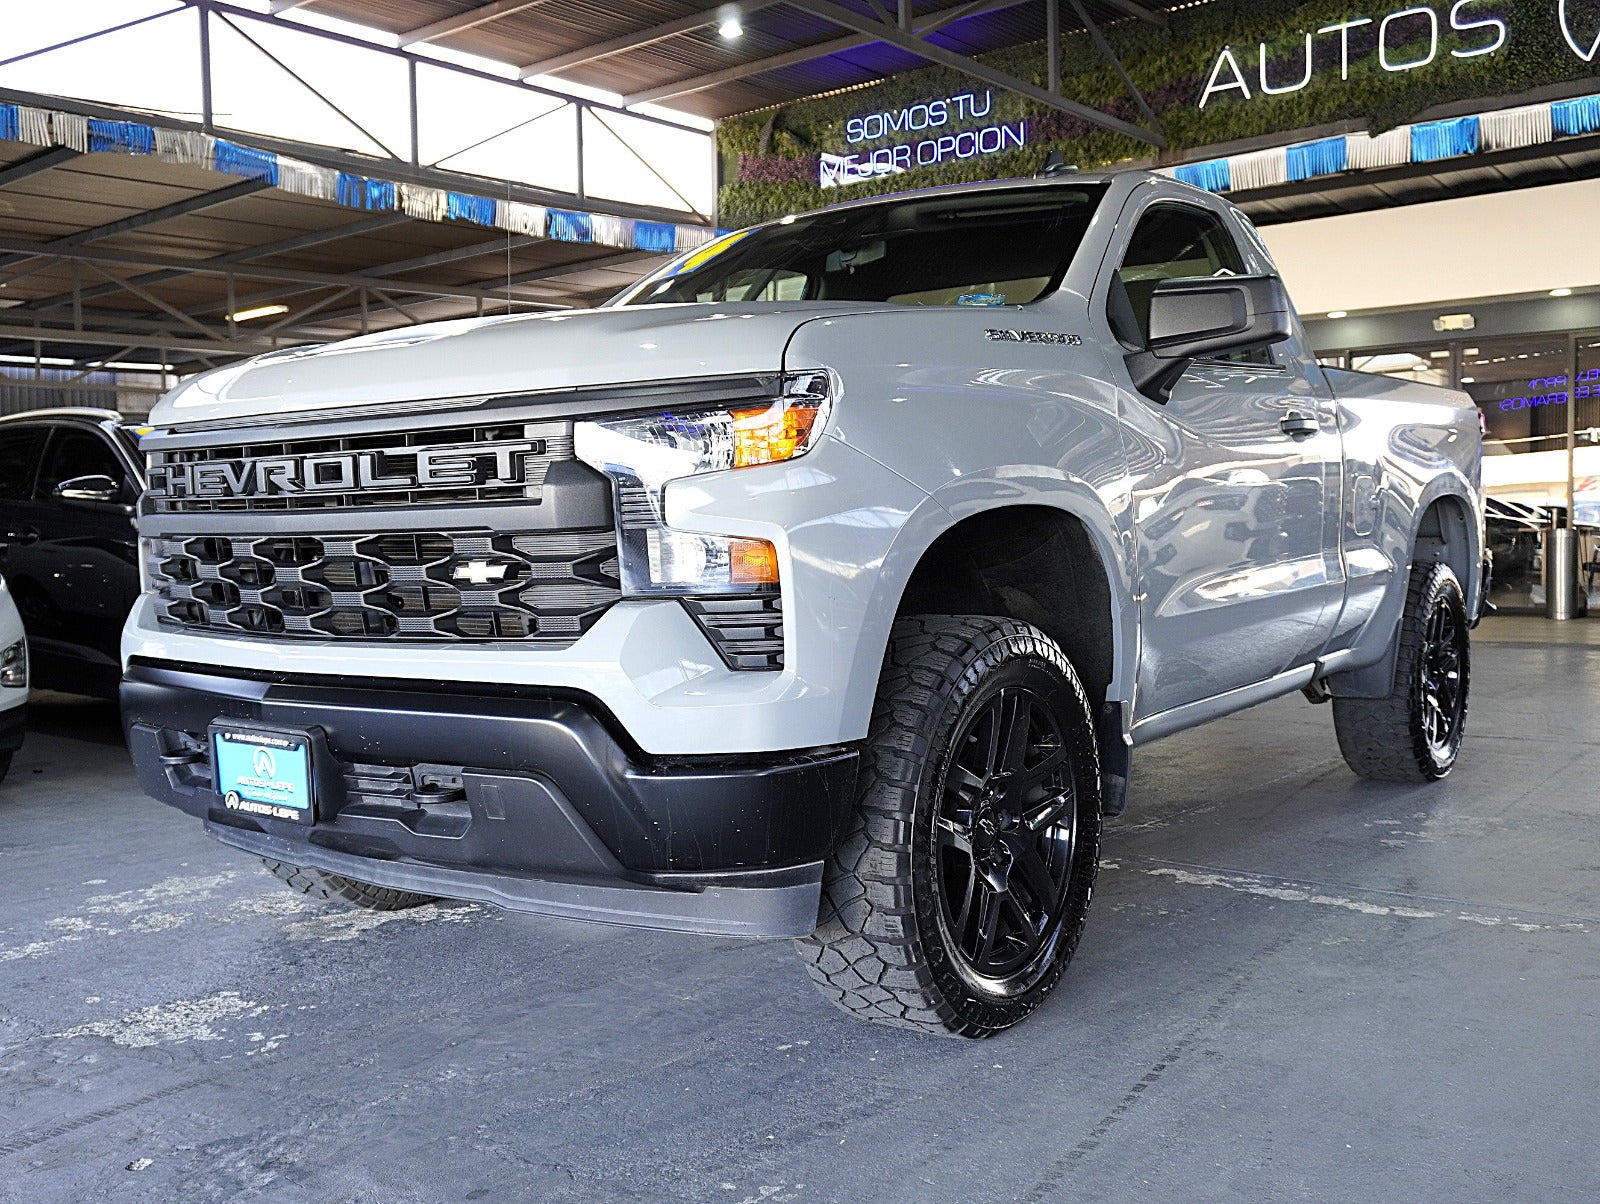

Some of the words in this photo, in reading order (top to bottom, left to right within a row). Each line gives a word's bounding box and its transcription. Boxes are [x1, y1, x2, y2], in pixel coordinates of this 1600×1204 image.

[1198, 0, 1506, 108] AUTOS
[846, 101, 948, 143] SOMOS
[952, 90, 991, 120] TU
[819, 145, 911, 185] MEJOR
[917, 121, 1025, 166] OPCION
[984, 328, 1082, 346] SILVERADO
[145, 438, 546, 499] CHEVROLET
[239, 801, 273, 815] AUTOS
[273, 807, 300, 820] LEPE
